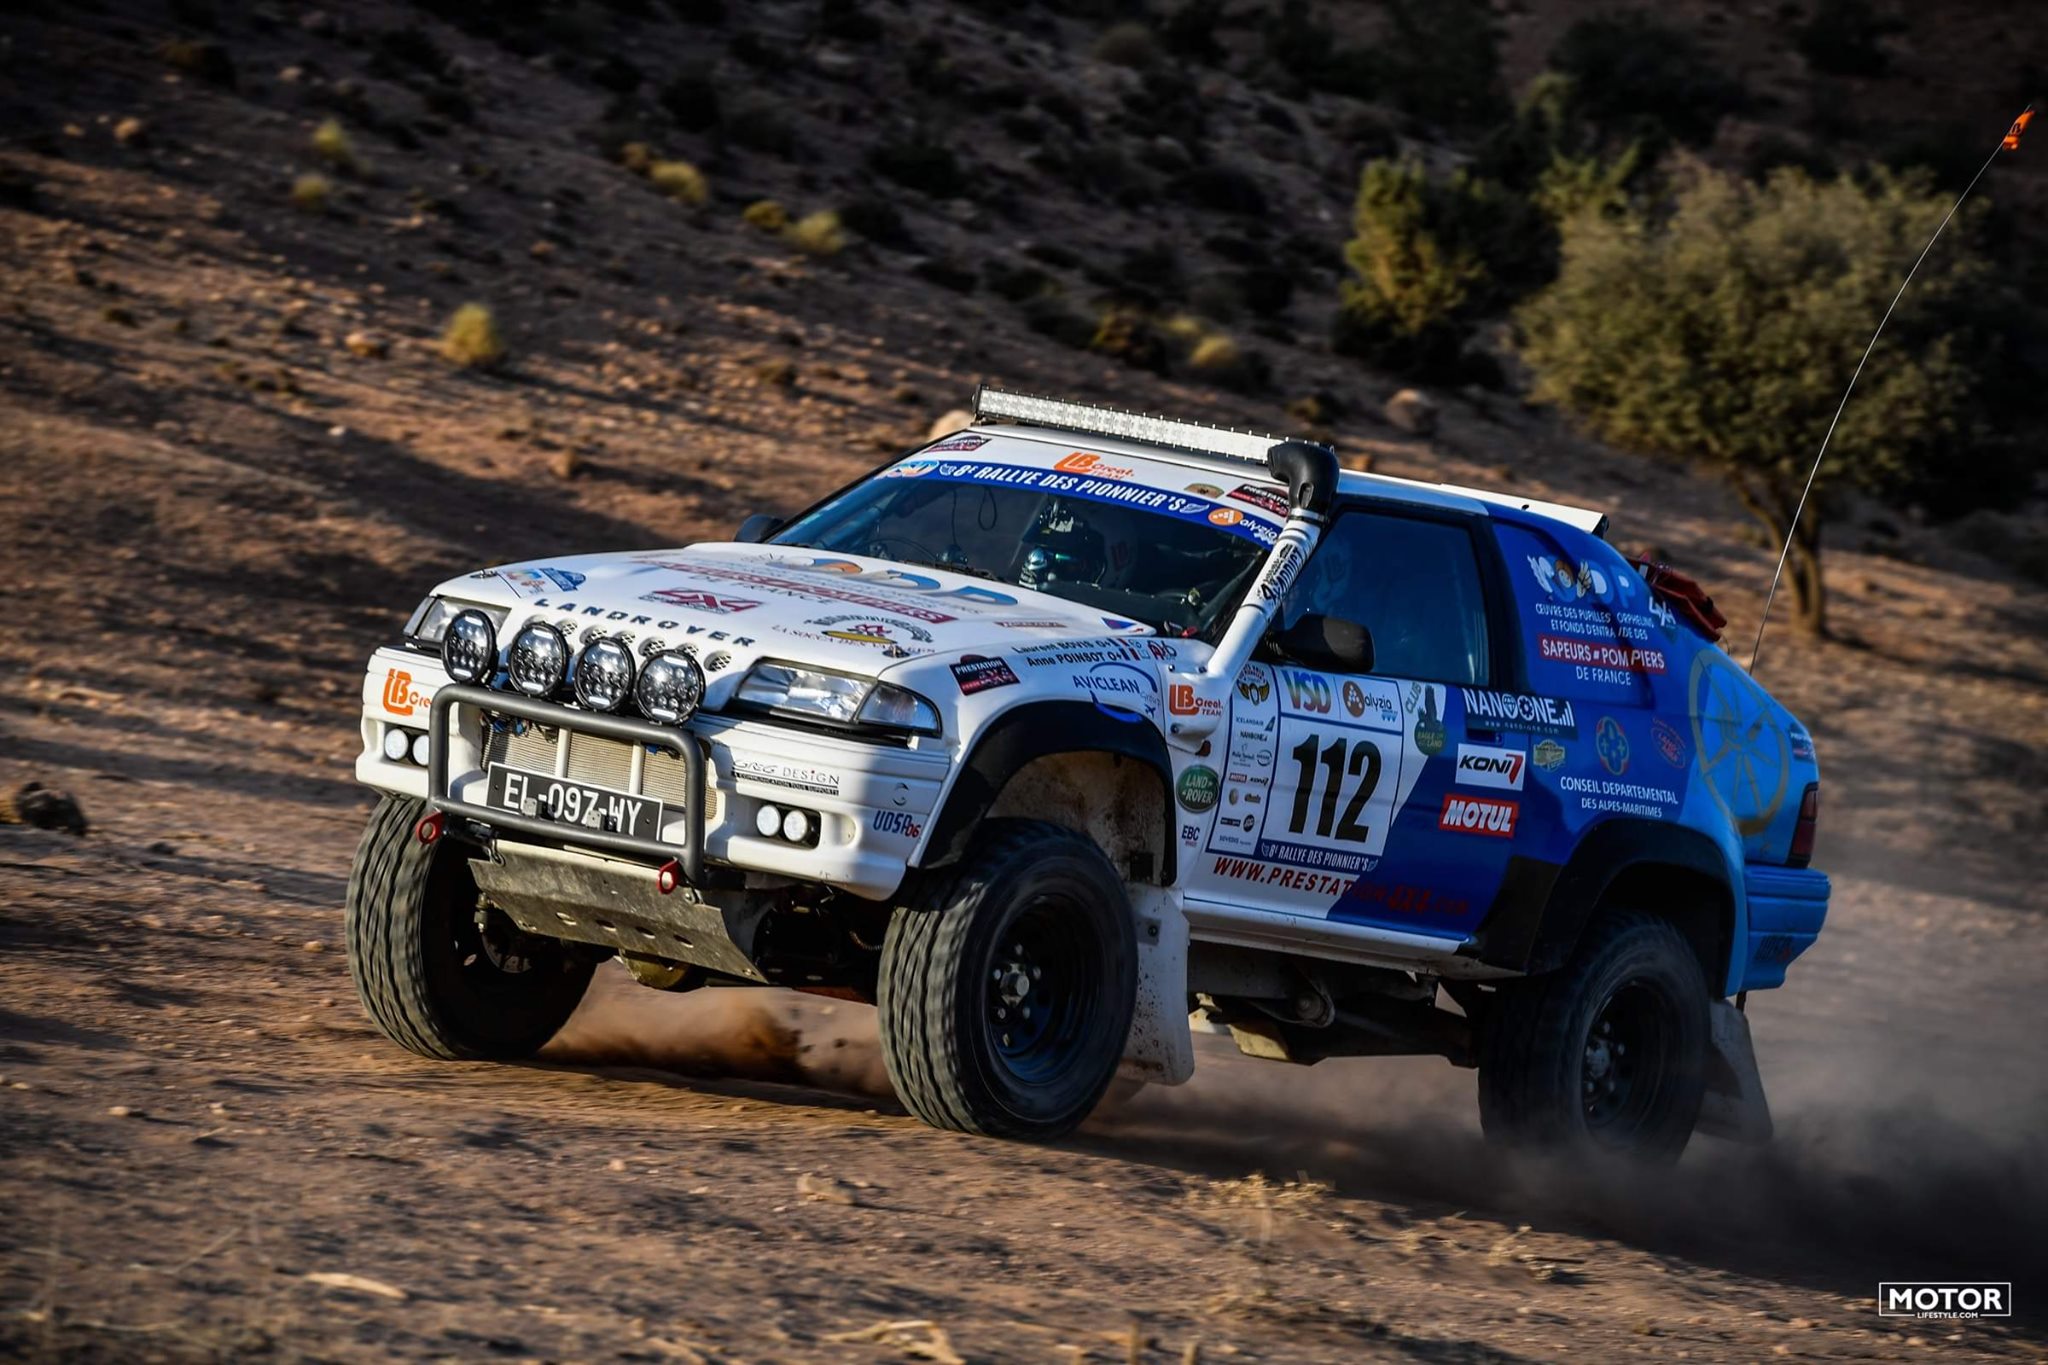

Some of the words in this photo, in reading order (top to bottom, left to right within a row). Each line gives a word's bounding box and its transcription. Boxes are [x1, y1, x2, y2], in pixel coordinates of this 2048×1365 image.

[973, 465, 1038, 485] RALLYE
[1040, 474, 1074, 490] DES
[1075, 478, 1184, 512] PIONNIER'S
[1242, 485, 1290, 505] PRESTATIO
[1563, 605, 1578, 619] DES
[1578, 608, 1611, 623] PUPILLES
[1550, 618, 1560, 631] ET
[1560, 620, 1585, 635] FONDS
[1634, 627, 1648, 640] DES
[954, 660, 1003, 675] PRESTATION
[1026, 656, 1055, 667] Anne
[1055, 651, 1105, 664] POINSOT
[1072, 675, 1141, 694] AVICLEAN
[1576, 665, 1589, 681] DE
[1592, 668, 1632, 686] FRANCE
[1281, 669, 1332, 714] VSD
[1364, 692, 1392, 710] alyzia
[1405, 680, 1422, 714] CLUB
[1201, 708, 1222, 717] TEAM
[1458, 754, 1513, 774] KONI
[1185, 774, 1208, 789] LAND
[1288, 733, 1383, 844] 112
[1560, 776, 1601, 794] CONSEIL
[1602, 781, 1679, 805] DEPARTEMENTAL
[1185, 788, 1214, 804] ROVER
[1442, 799, 1514, 832] MOTUL
[1581, 797, 1597, 809] DES
[1598, 799, 1663, 818] ALPES-MARITIMES
[1181, 825, 1200, 841] EBC
[1278, 845, 1308, 864] RALLYE
[1307, 848, 1322, 866] DES
[1322, 851, 1369, 873] PIONNIER'S
